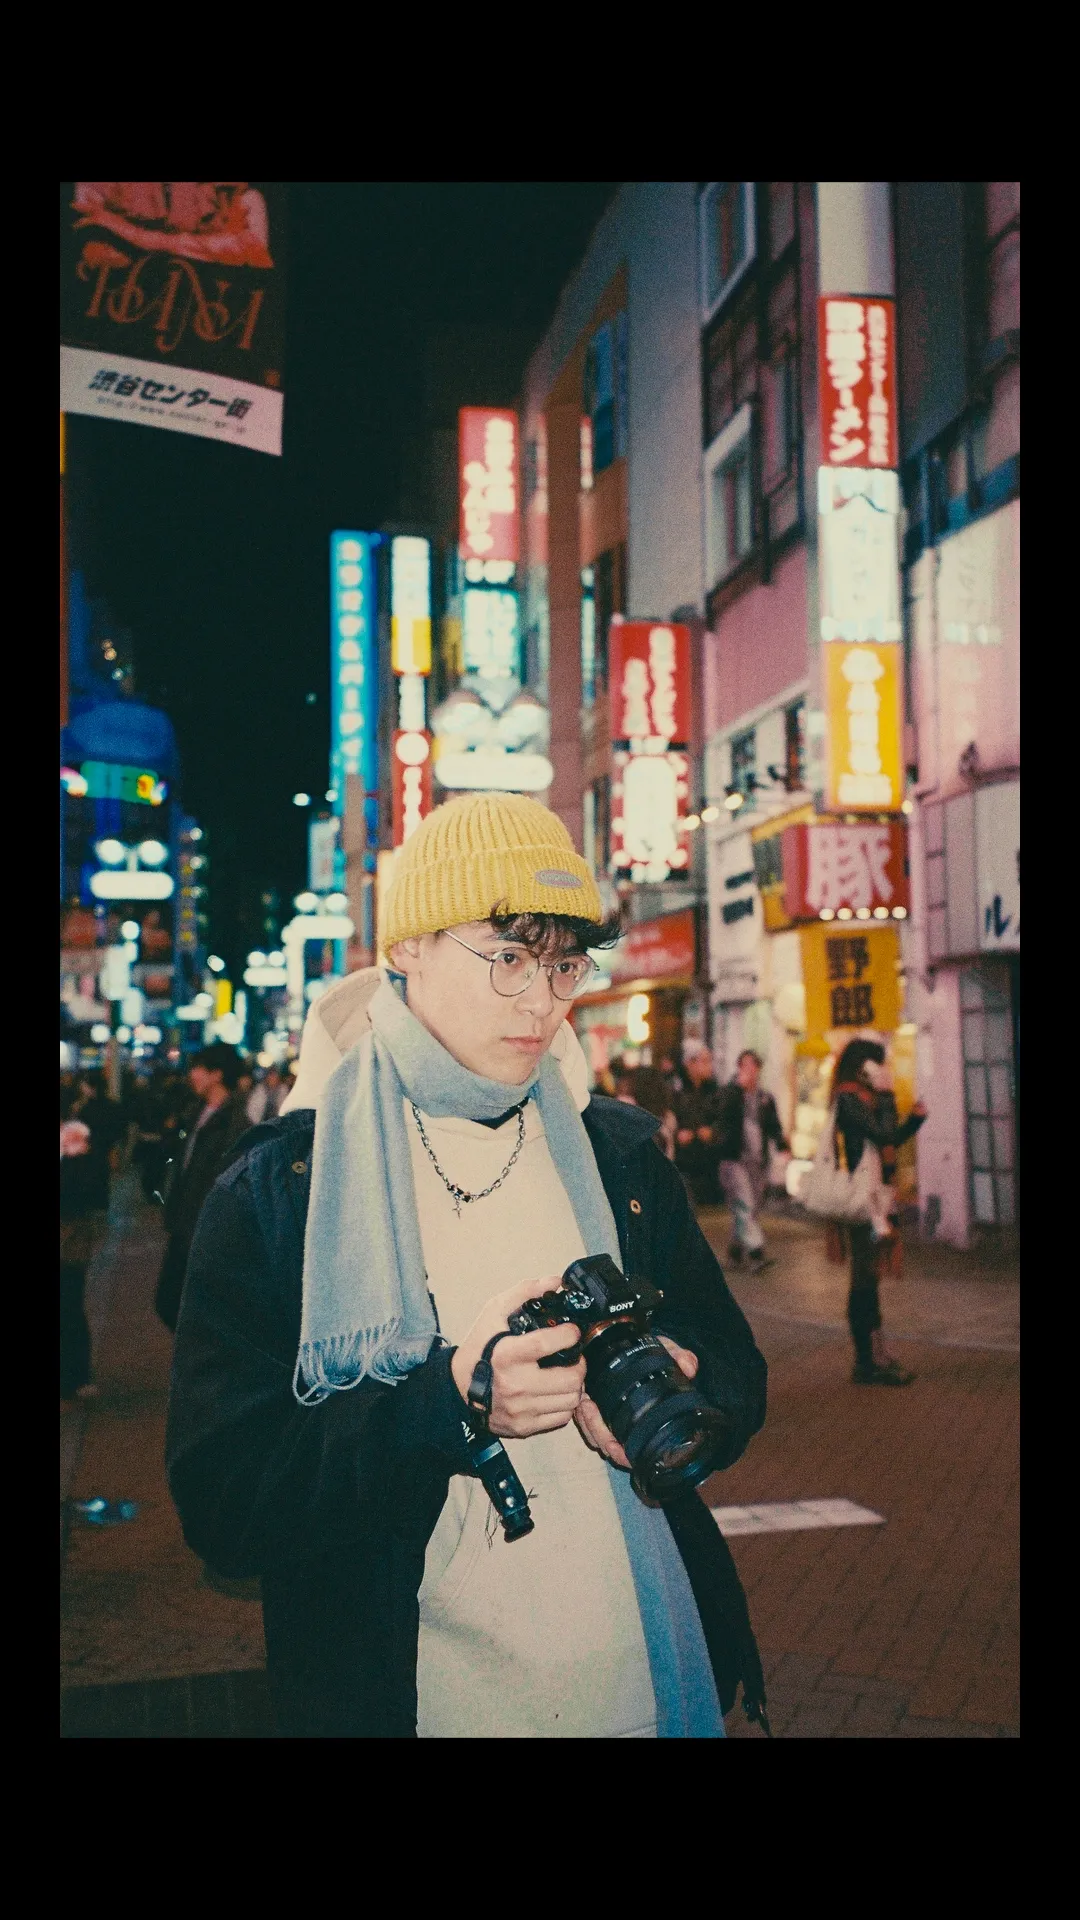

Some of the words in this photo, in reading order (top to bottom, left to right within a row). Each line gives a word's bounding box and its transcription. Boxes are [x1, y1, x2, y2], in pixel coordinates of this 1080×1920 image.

[87, 368, 253, 420] 渋谷センター街
[805, 823, 895, 910] 豚
[826, 936, 876, 1027] 野郎
[609, 1300, 635, 1313] SONY
